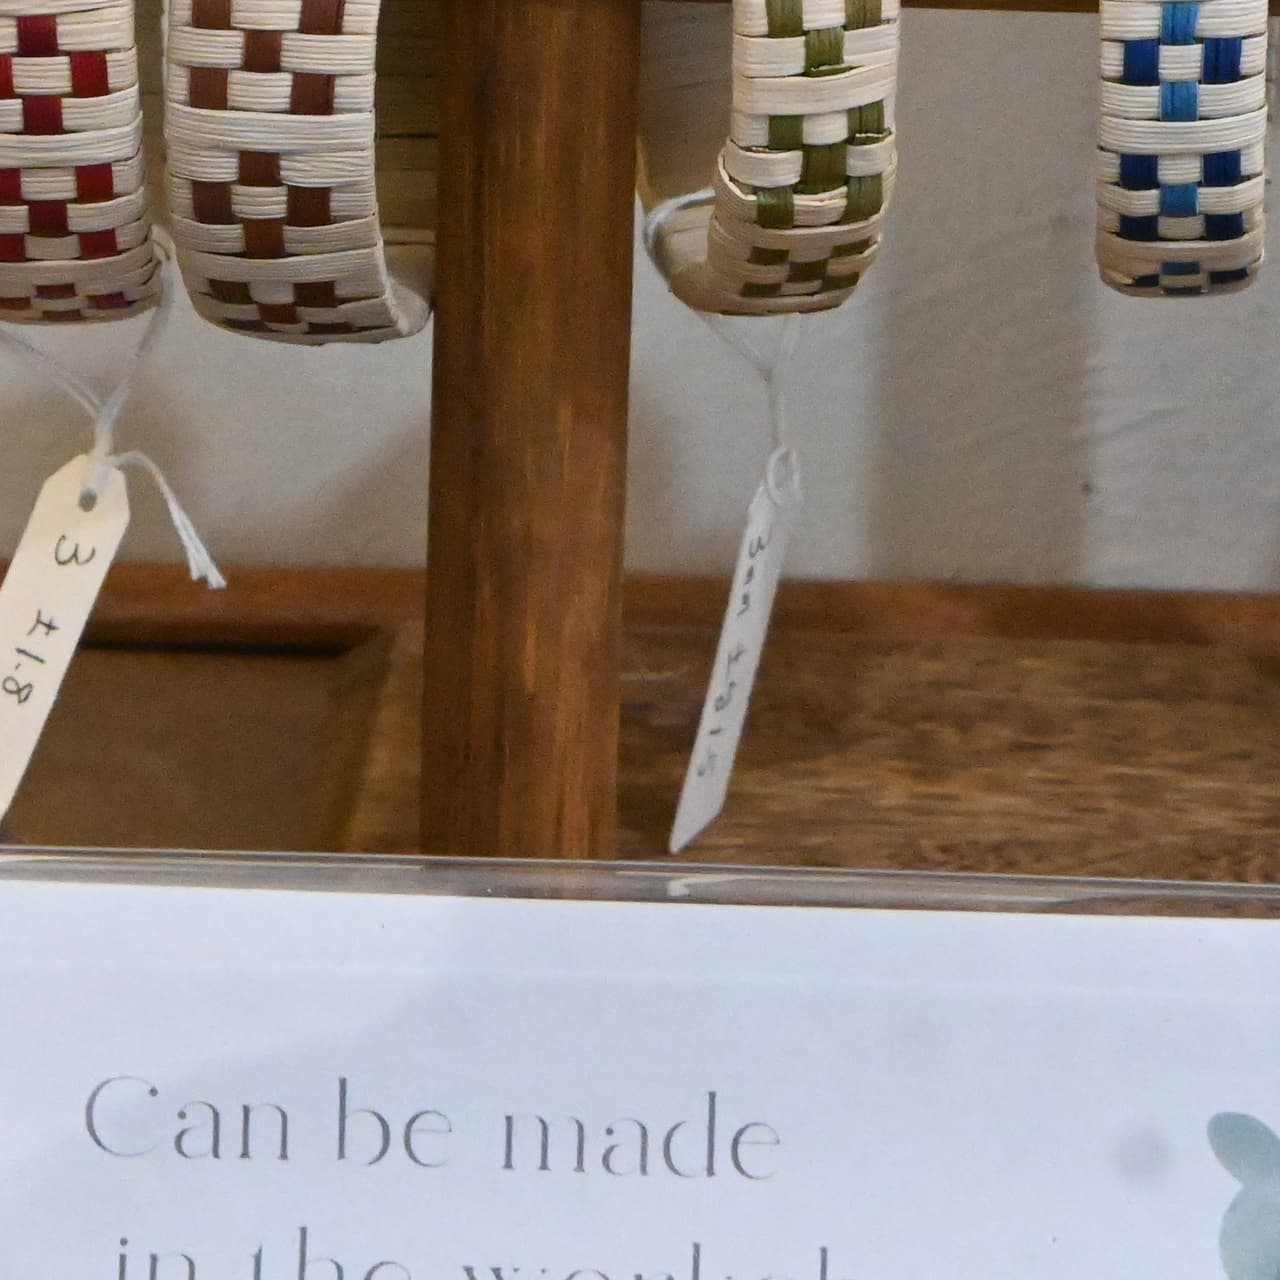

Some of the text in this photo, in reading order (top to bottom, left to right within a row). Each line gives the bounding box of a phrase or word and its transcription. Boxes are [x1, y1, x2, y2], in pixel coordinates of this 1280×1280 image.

[84, 1075, 782, 1181] Can be made
